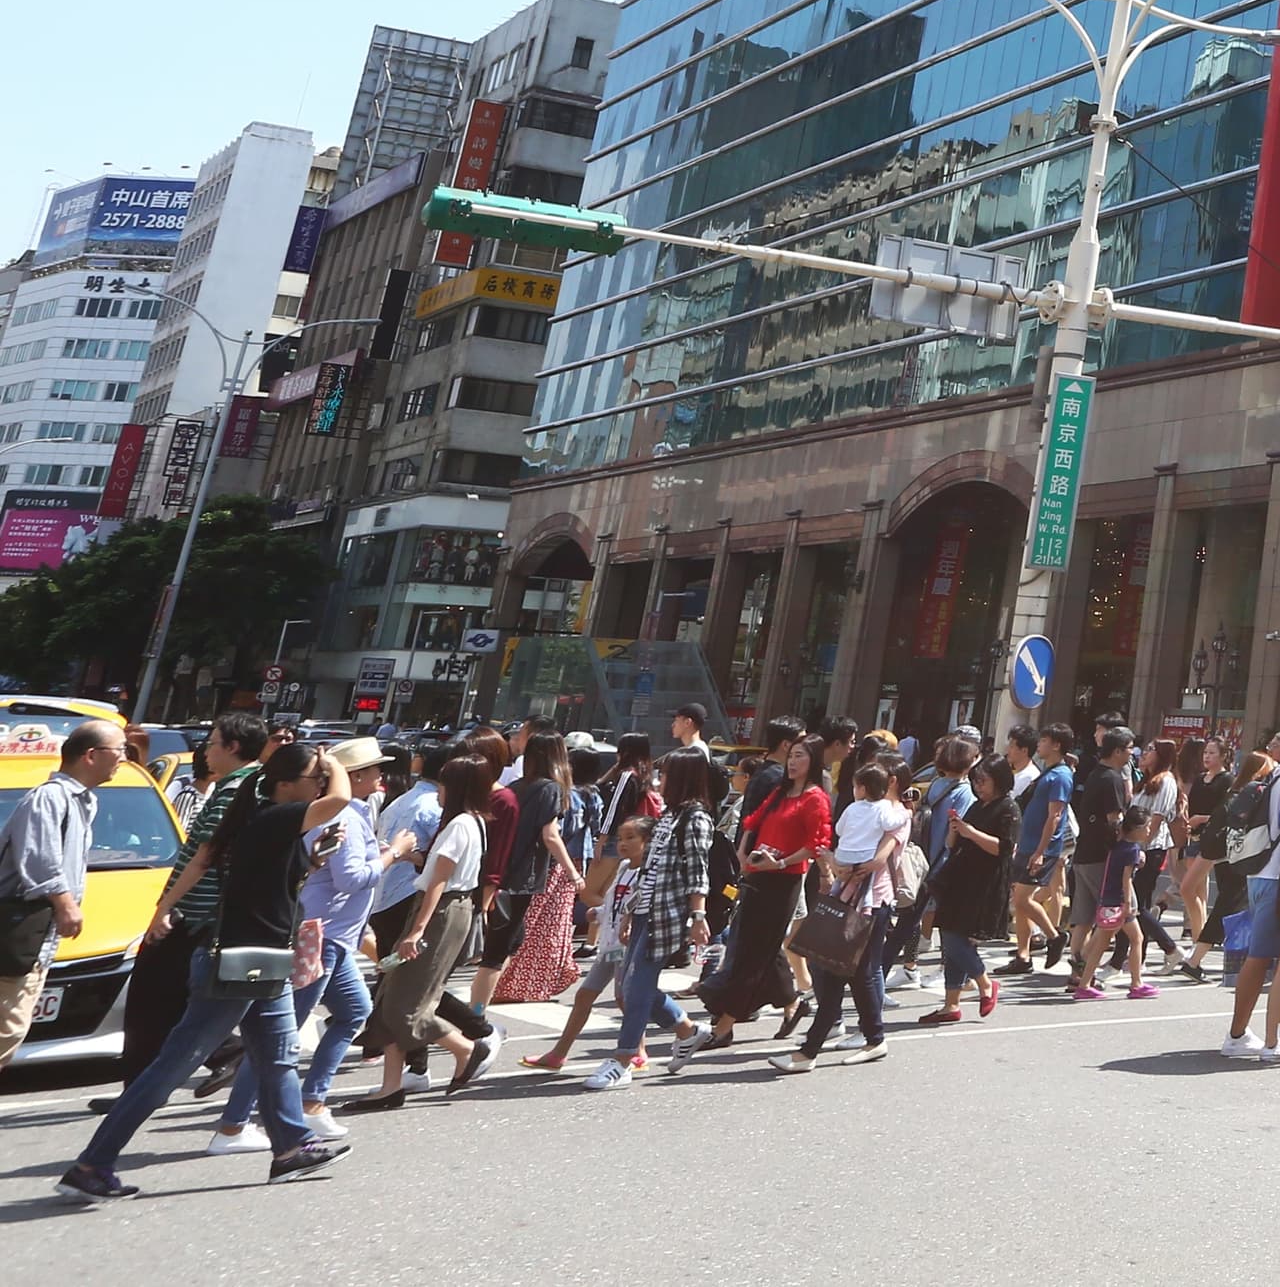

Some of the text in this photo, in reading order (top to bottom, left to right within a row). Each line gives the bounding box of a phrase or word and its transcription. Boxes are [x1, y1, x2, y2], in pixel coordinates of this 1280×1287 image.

[101, 212, 187, 230] 2571-2888
[1049, 398, 1082, 496] 南京西路
[112, 442, 136, 491] AVON
[1042, 497, 1062, 509] Nan
[1040, 511, 1062, 524] Jing
[1038, 523, 1067, 535] W. Rd.
